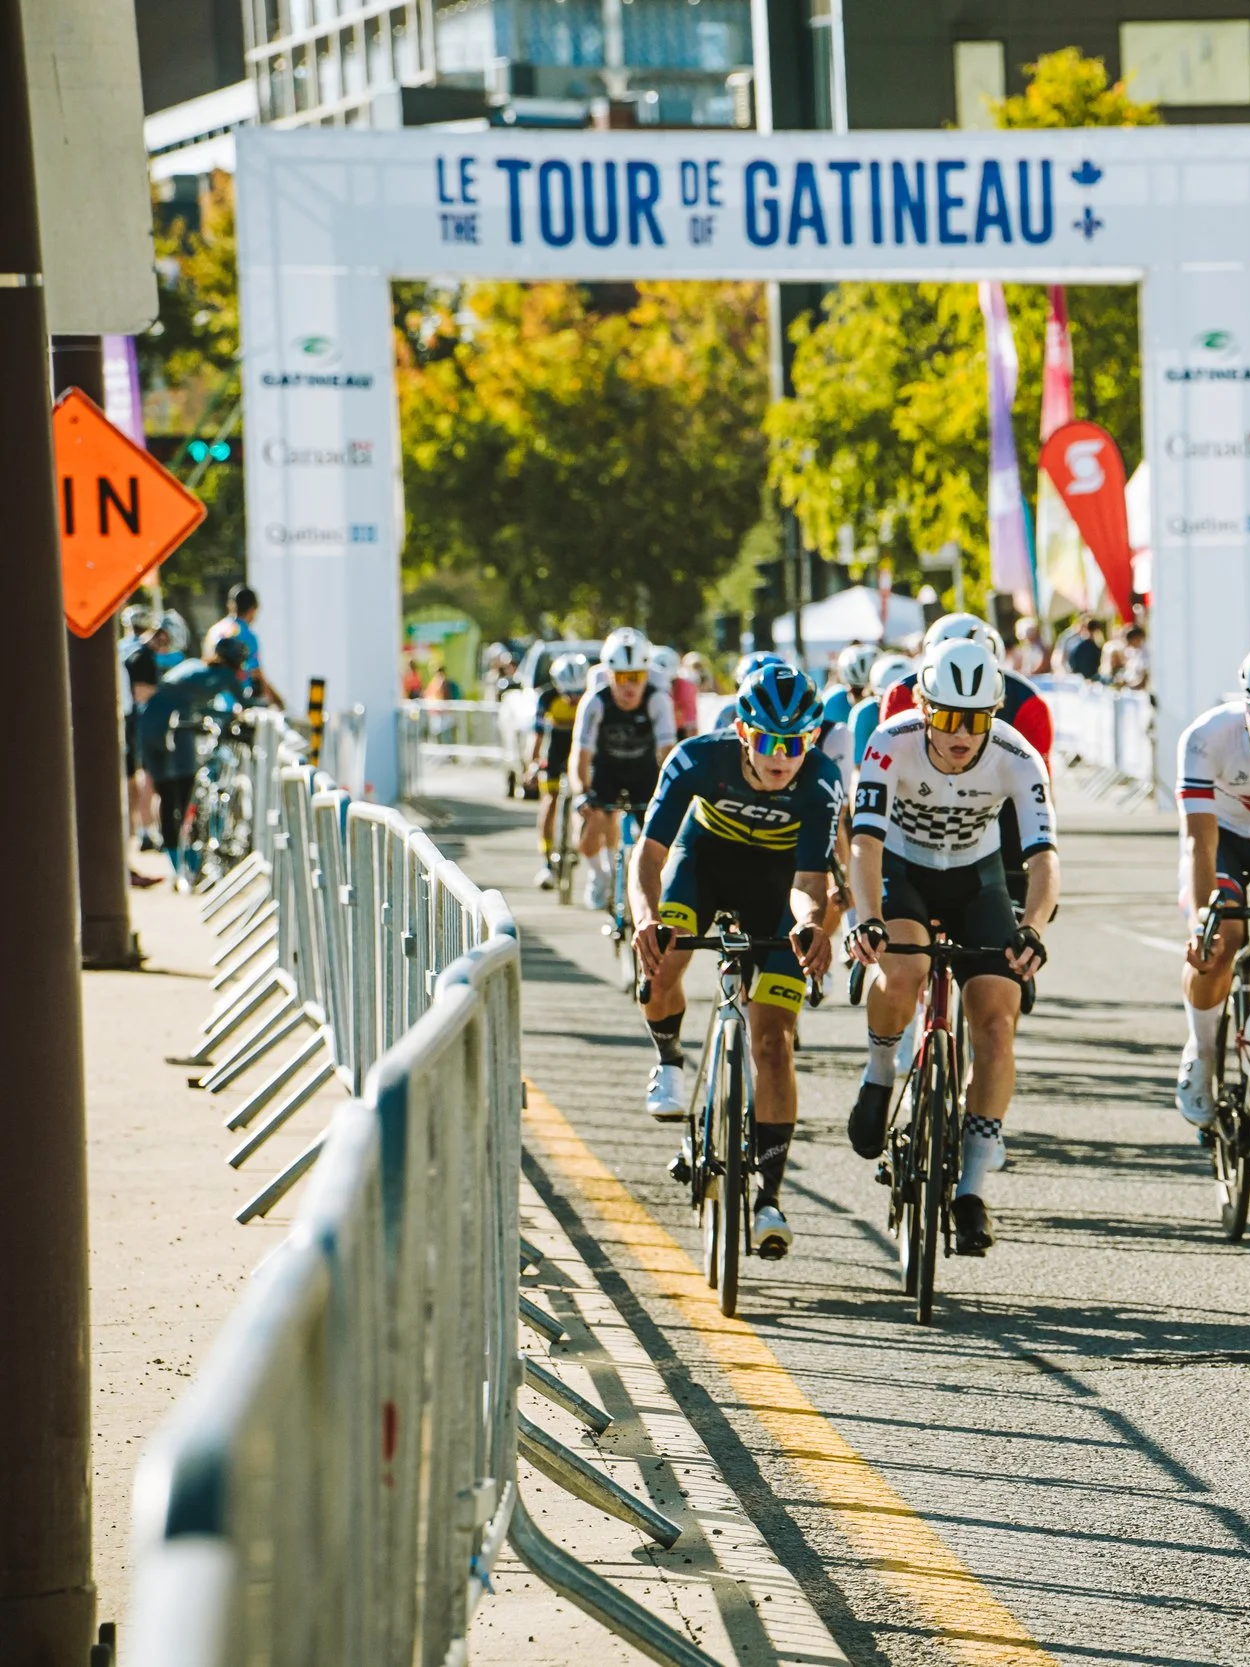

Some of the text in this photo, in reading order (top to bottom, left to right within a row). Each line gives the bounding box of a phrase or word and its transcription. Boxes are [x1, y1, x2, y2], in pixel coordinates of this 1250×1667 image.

[436, 156, 1054, 248] LE TOUR DE GATINEAU
[440, 212, 715, 246] THE OF
[261, 373, 374, 388] GATINEAU
[262, 435, 374, 467] Canada
[991, 734, 1031, 761] SHIMANO
[855, 788, 880, 808] 3T
[714, 799, 792, 823] CCN
[768, 984, 802, 1004] CCN
